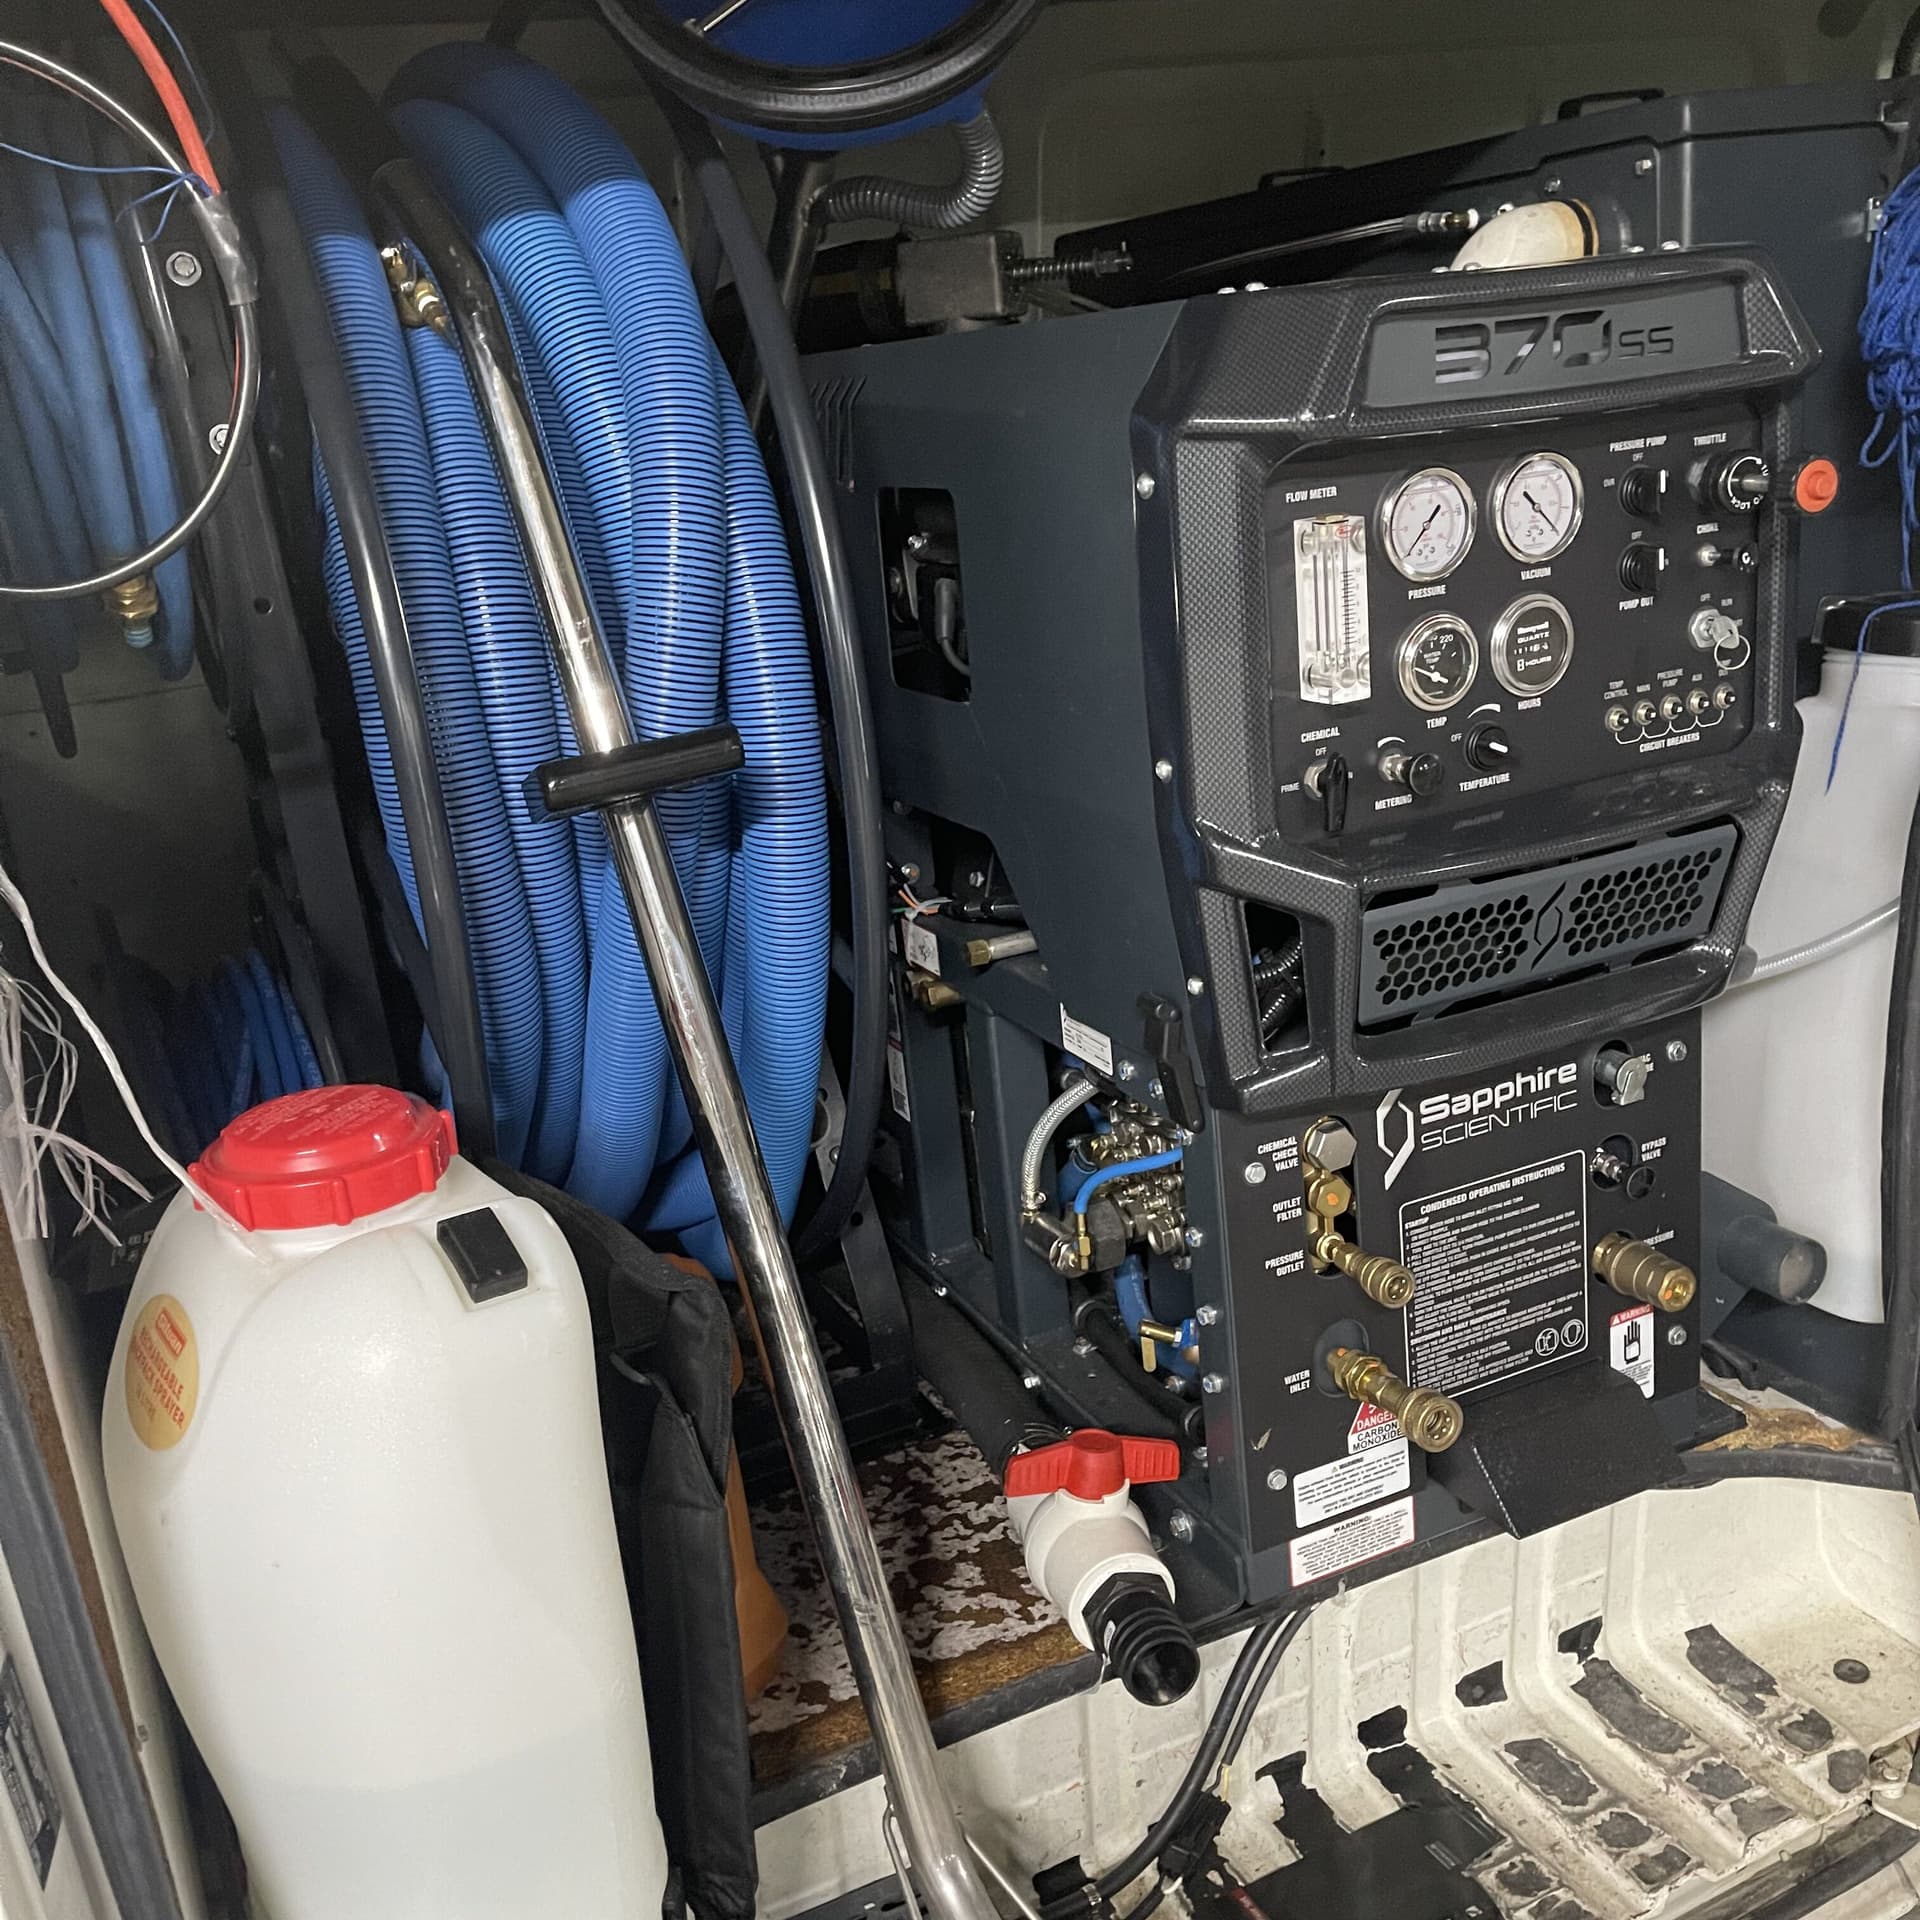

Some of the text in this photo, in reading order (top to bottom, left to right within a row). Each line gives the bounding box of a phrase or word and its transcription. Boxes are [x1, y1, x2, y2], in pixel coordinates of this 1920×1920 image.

[1435, 310, 1612, 384] 370
[1610, 435, 1667, 452] PRESSURE PUMP
[1694, 432, 1727, 446] THROTTLE
[1285, 486, 1337, 503] FLOW METER
[1697, 523, 1719, 534] CHOKE
[1521, 566, 1551, 581] VACUUM
[1408, 584, 1446, 599] PRESSURE
[1619, 596, 1654, 611] PUMP OUT
[1439, 634, 1454, 643] 220
[1517, 632, 1550, 644] QUARTZ
[1517, 697, 1541, 711] HOURS
[1426, 716, 1447, 729] TEMP
[1301, 726, 1340, 743] CHEMICAL
[1451, 733, 1462, 742] OFF
[1640, 732, 1700, 752] CIRCUIT BREAKERS
[1315, 746, 1327, 756] OFF
[1280, 782, 1300, 794] PRIME
[1459, 772, 1511, 792] TEMPERATURE
[1374, 794, 1412, 811] METERING
[1419, 1062, 1577, 1125] Sapphire
[1420, 1089, 1578, 1152] SCIENTIFIC
[1257, 1136, 1297, 1155] CHEMICAL
[1641, 1136, 1667, 1153] BYPASS
[1272, 1147, 1298, 1162] CHECK
[1641, 1148, 1662, 1162] VALVE
[1274, 1158, 1299, 1172] VALVE
[1420, 1162, 1566, 1216] CONDENSED OPERATING INSTRUCTIONS
[1272, 1196, 1301, 1213] OUTLET
[1276, 1207, 1302, 1223] FILTER
[1265, 1249, 1304, 1270] PRESSURE
[1276, 1260, 1305, 1277] OUTLET
[1284, 1369, 1310, 1385] WATER
[1289, 1379, 1311, 1394] INLET
[153, 1379, 185, 1430] SPRAYER
[1353, 1428, 1401, 1451] MONOXIDE
[1357, 1421, 1398, 1442] CARBON
